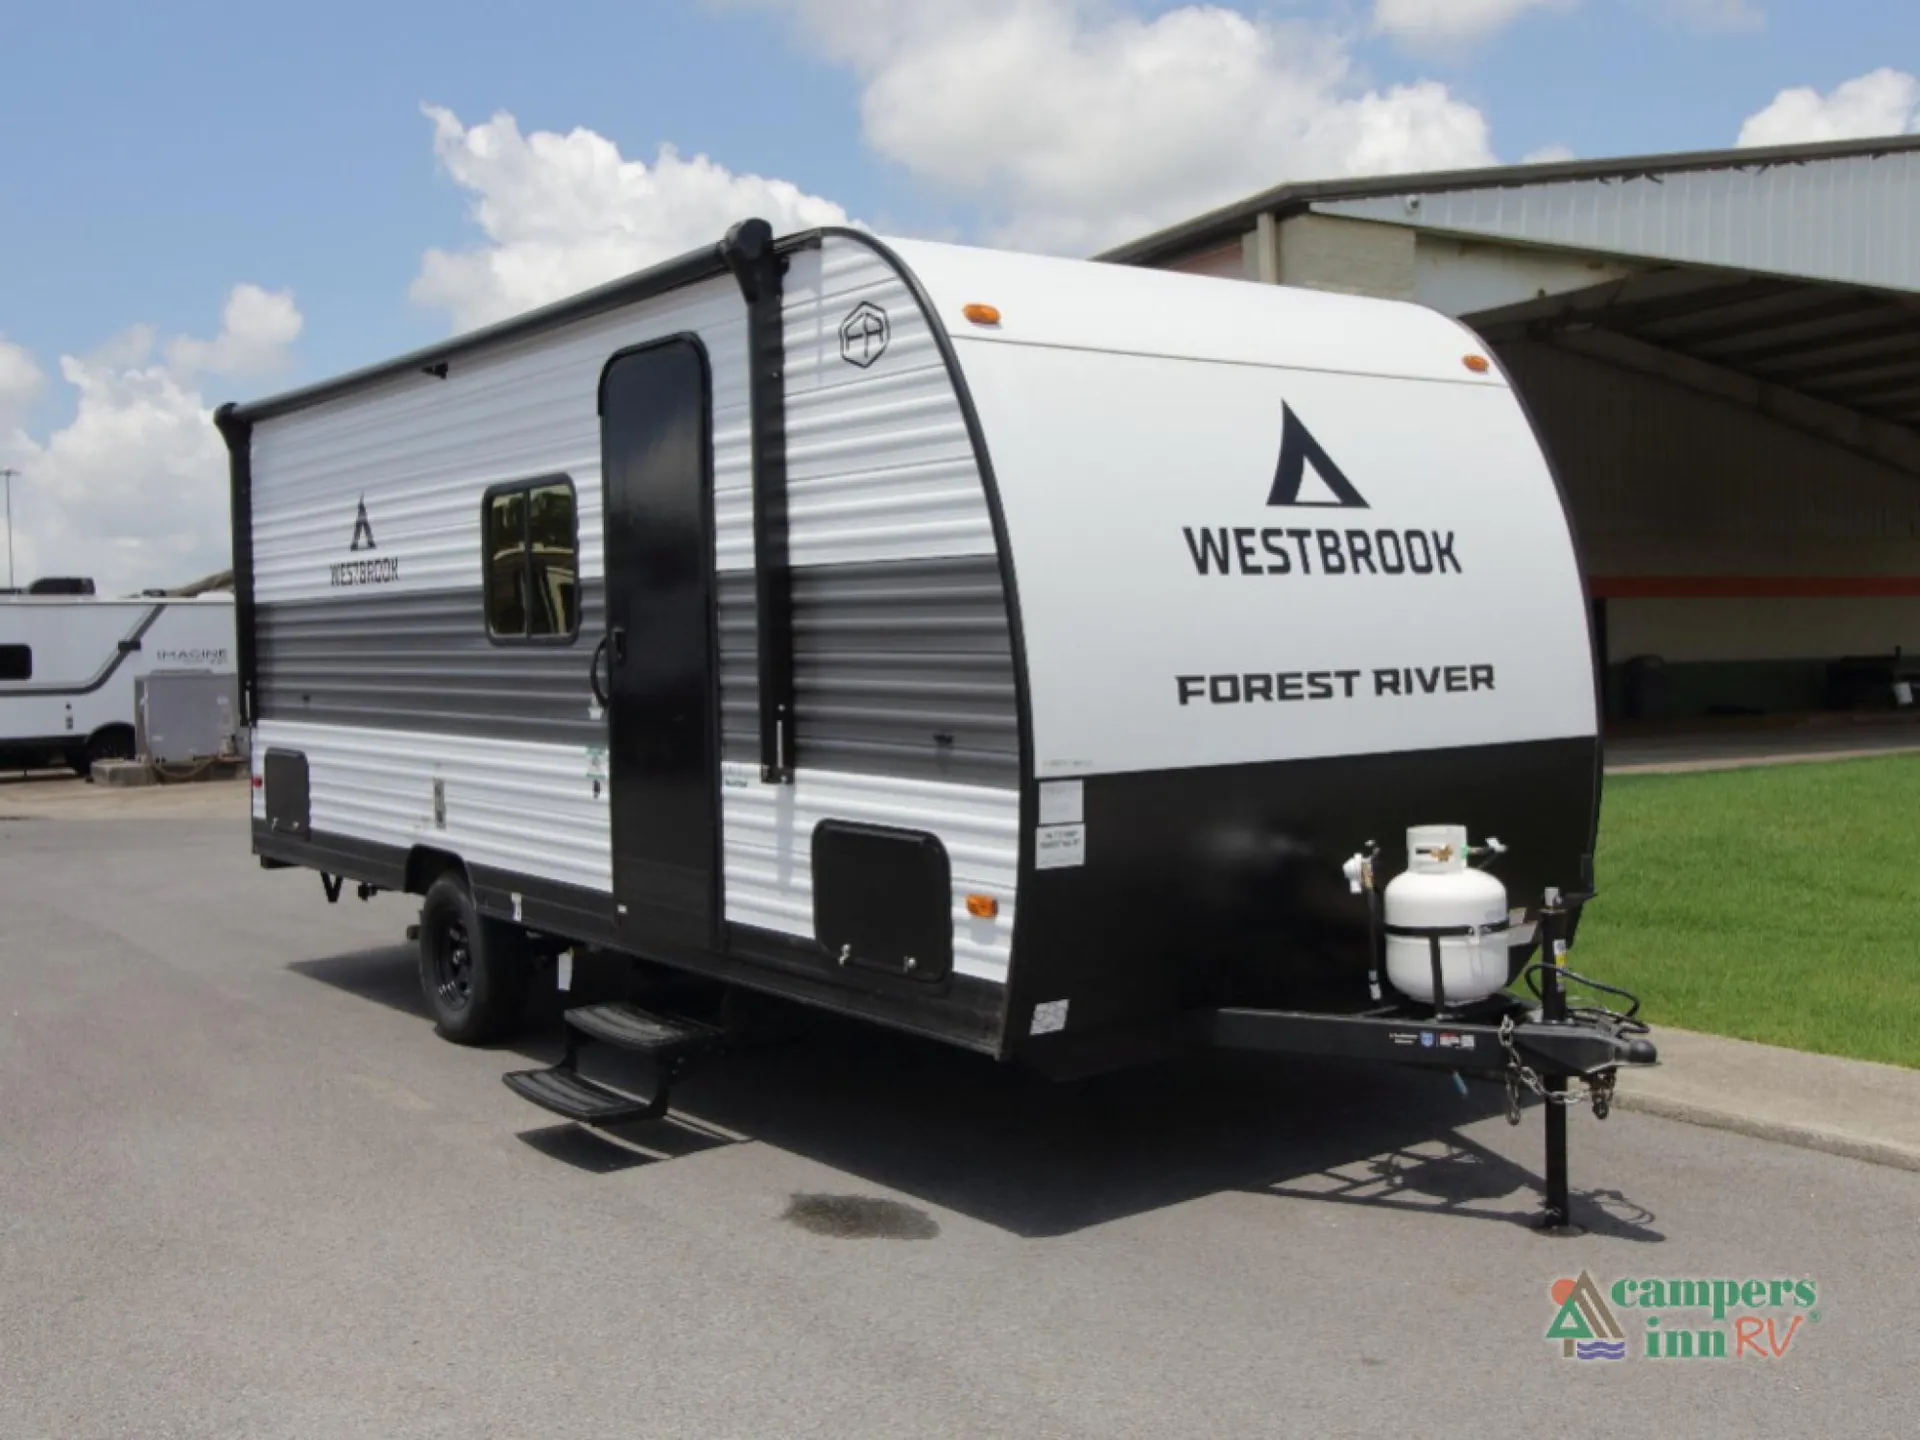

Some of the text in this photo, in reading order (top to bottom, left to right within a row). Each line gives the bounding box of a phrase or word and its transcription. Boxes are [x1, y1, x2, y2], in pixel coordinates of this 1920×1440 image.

[330, 557, 399, 586] WESTBROOK
[1183, 526, 1462, 575] WESTBROOK
[1175, 664, 1496, 706] FOREST RIVER
